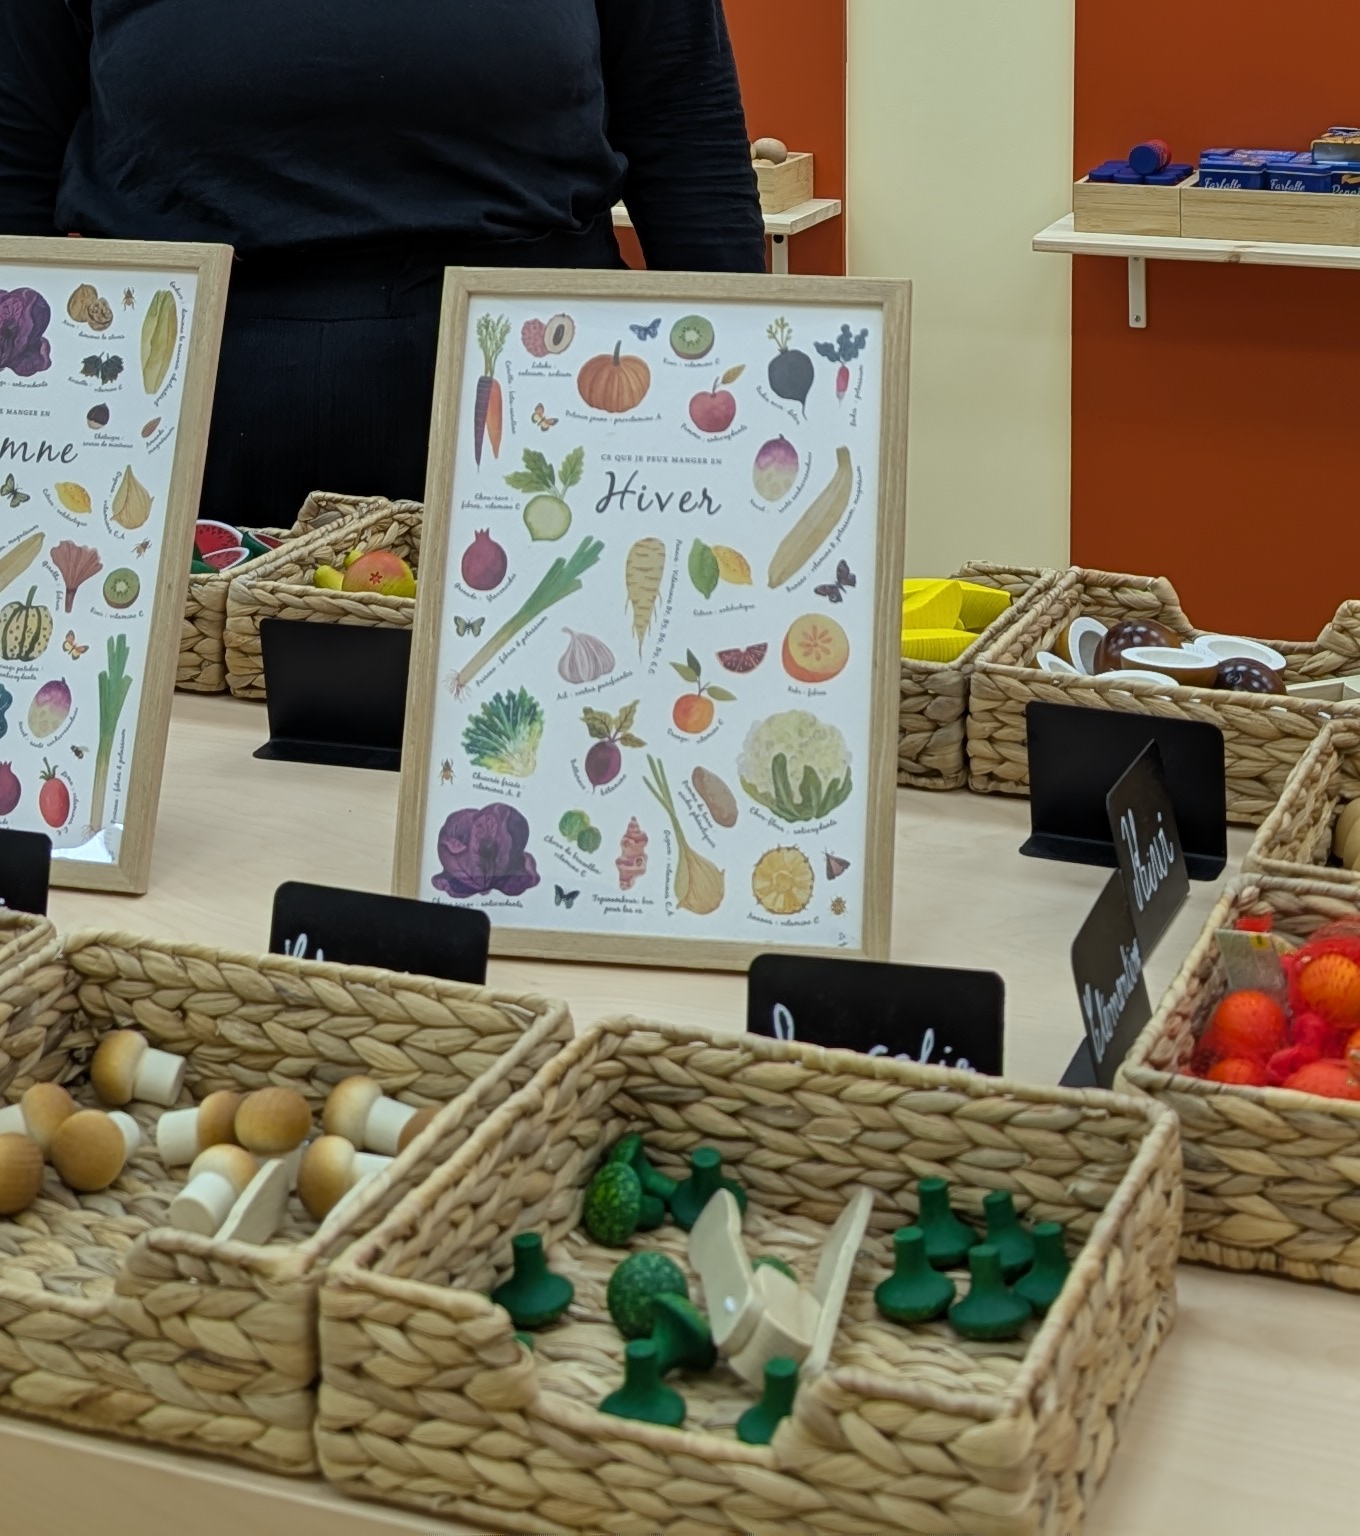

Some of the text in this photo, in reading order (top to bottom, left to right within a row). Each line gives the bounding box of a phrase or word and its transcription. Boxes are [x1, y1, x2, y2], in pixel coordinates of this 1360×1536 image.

[7, 408, 38, 416] MANGER
[600, 453, 723, 465] CE QUE JE PEUX MANGER EN
[595, 469, 723, 515] Hiver
